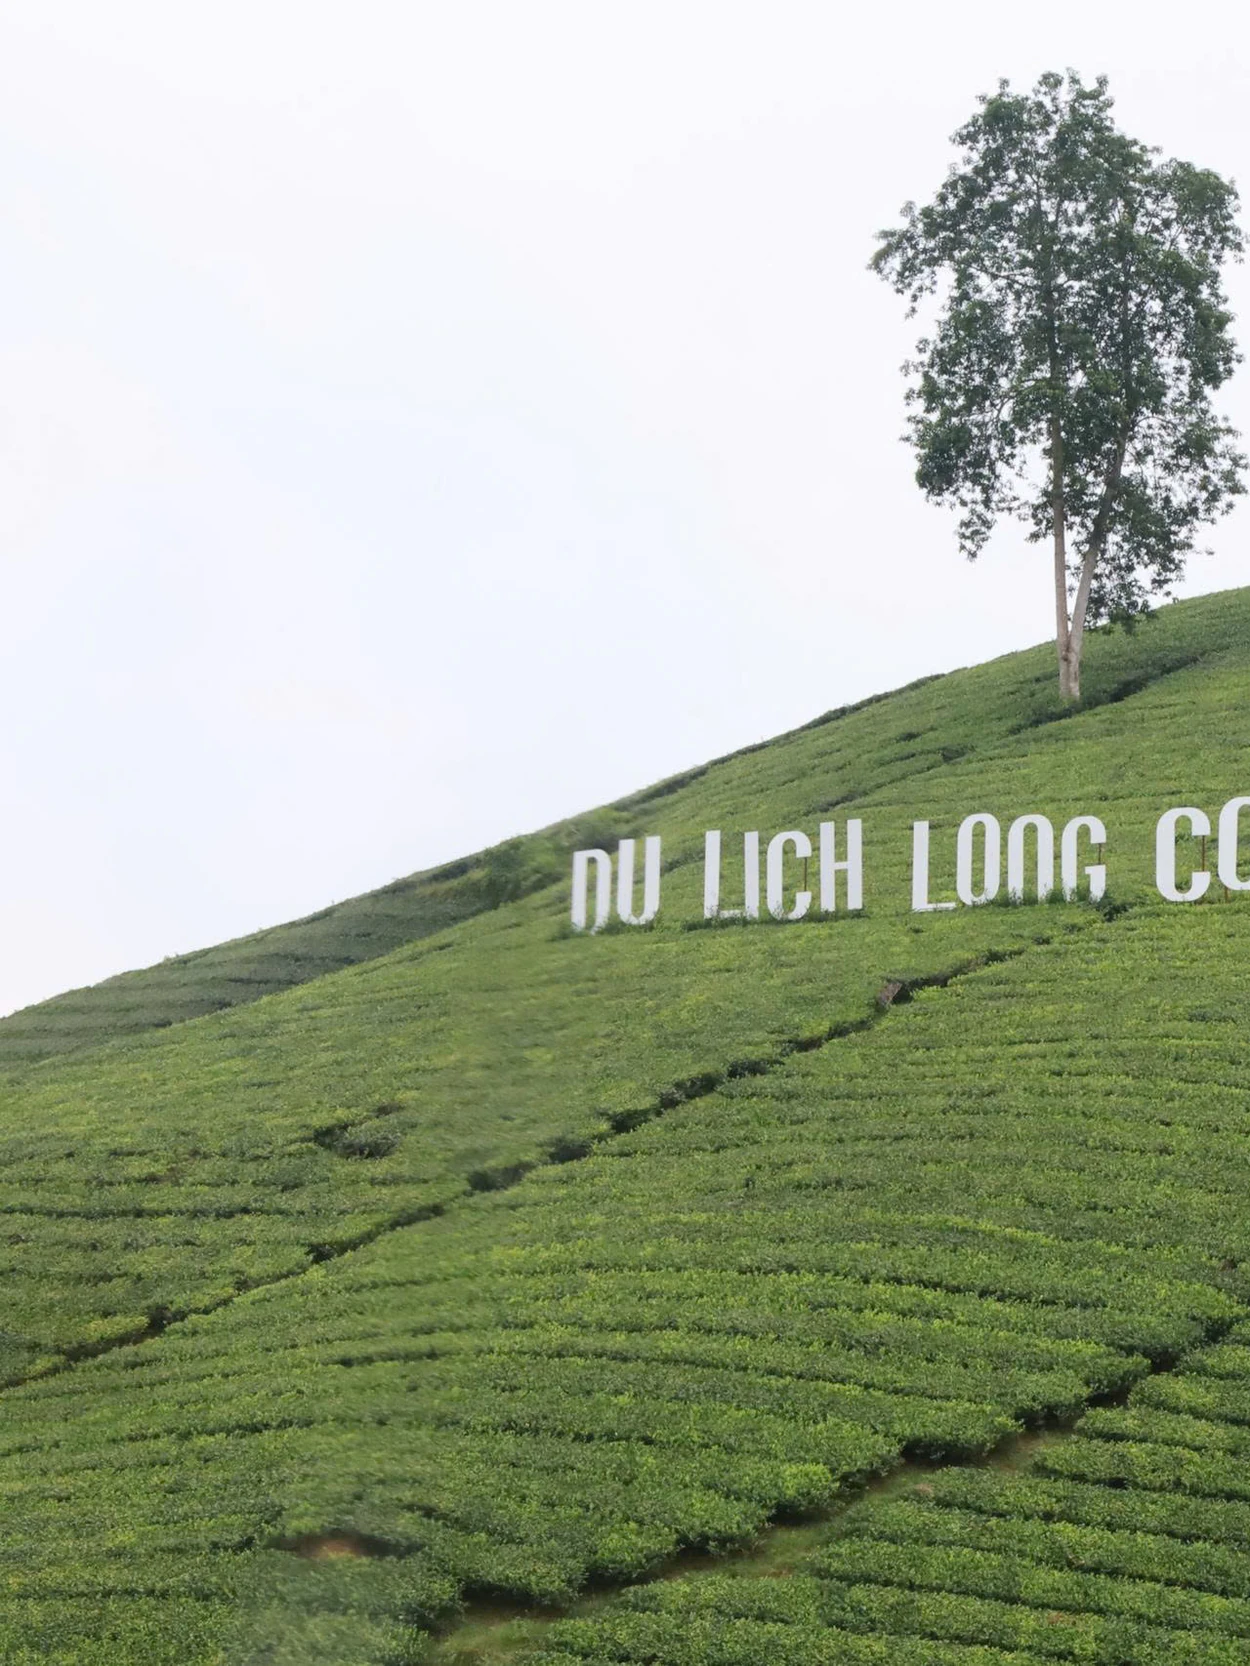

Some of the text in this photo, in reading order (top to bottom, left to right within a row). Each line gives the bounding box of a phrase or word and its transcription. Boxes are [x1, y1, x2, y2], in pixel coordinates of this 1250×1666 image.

[571, 835, 661, 936] DU
[703, 818, 863, 921] LICH
[911, 812, 1107, 912] LONG
